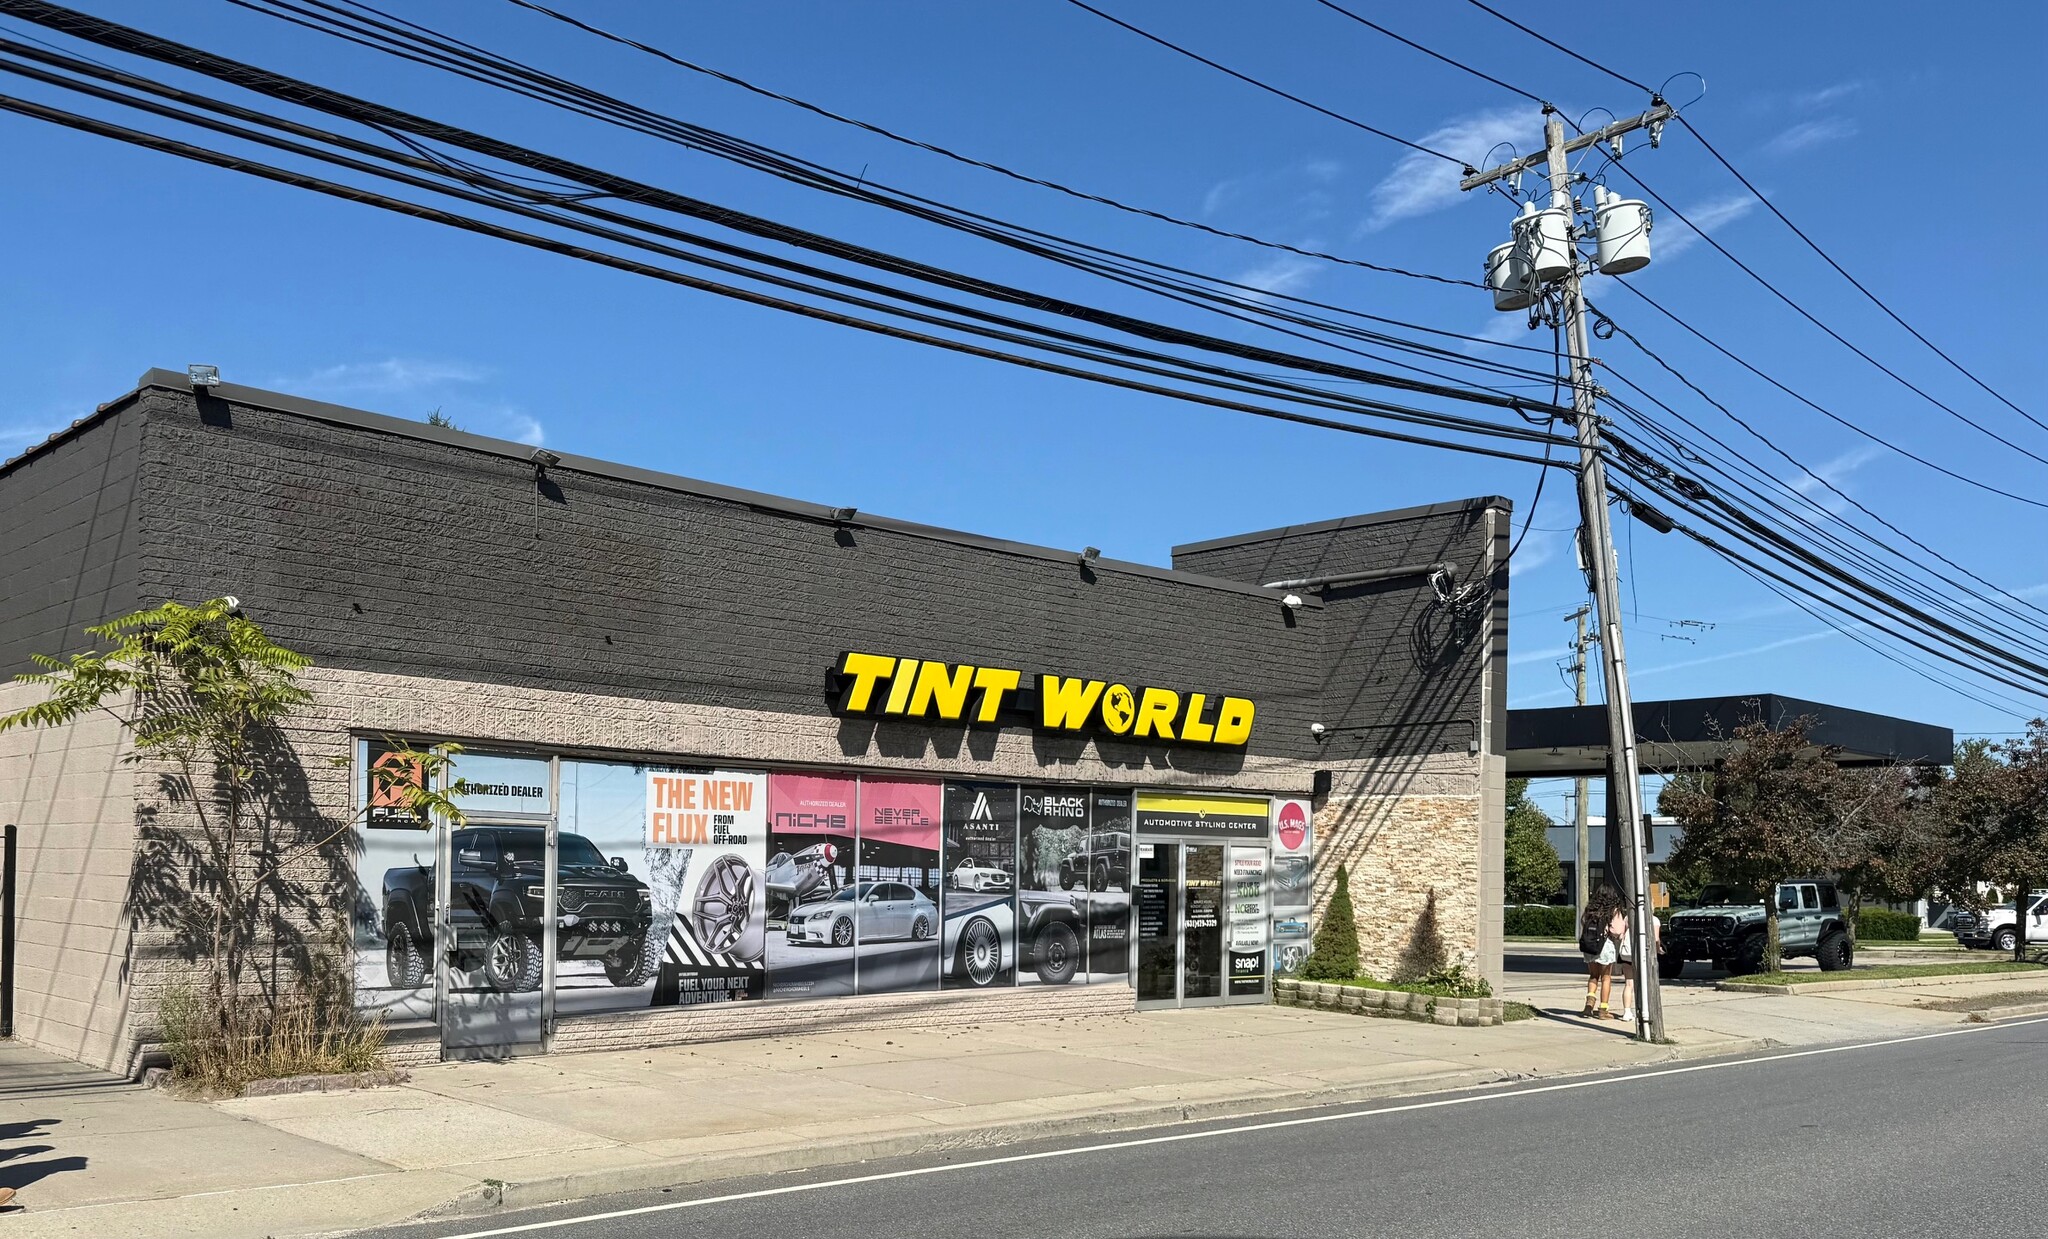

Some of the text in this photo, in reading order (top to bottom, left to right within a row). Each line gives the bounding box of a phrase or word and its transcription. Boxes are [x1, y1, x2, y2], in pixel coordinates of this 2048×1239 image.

[843, 652, 1256, 745] TINT WORLD
[455, 782, 543, 798] THORIZED DEALER
[653, 777, 753, 811] THE NEW
[1044, 796, 1084, 807] BLACK
[372, 807, 421, 819] FUEL
[874, 808, 920, 817] NEVER
[1044, 807, 1084, 817] RHINO
[713, 814, 734, 824] FROM
[874, 817, 929, 826] SETTLE
[1143, 819, 1192, 828] AUTOMOTIVE
[1195, 820, 1226, 829] STYLING
[653, 812, 708, 844] FLUX
[713, 825, 730, 834] FUEL
[963, 823, 999, 831] ASANTI
[1279, 819, 1289, 831] U.S.
[713, 835, 747, 845] OFF-ROAD
[1235, 955, 1259, 971] snap!
[679, 976, 749, 991] FUEL YOUR NEXT
[679, 990, 732, 1004] ADVENTURE.
